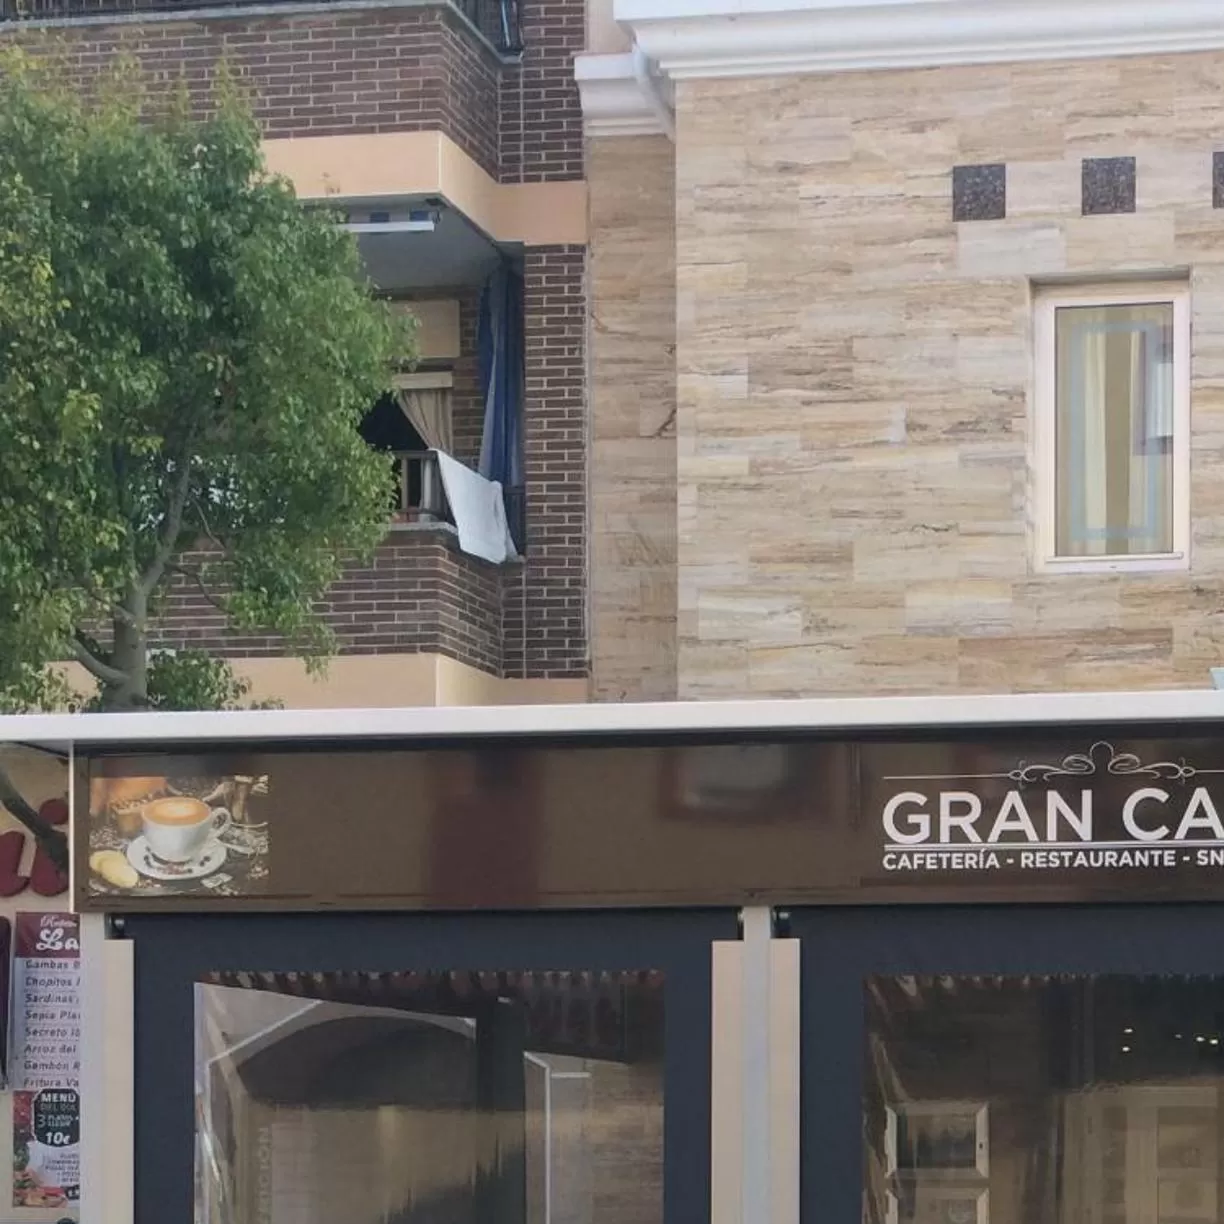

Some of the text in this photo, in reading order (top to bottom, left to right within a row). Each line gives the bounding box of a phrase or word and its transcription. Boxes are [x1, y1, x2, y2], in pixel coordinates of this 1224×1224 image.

[882, 788, 1092, 845] GRAN
[882, 848, 1000, 871] CAFETERÍA
[1020, 848, 1176, 869] RESTAURANTE
[25, 958, 69, 970] Gambas
[25, 975, 72, 988] Chopitos
[24, 1026, 67, 1037] Secreto
[24, 1043, 57, 1053] Arroz
